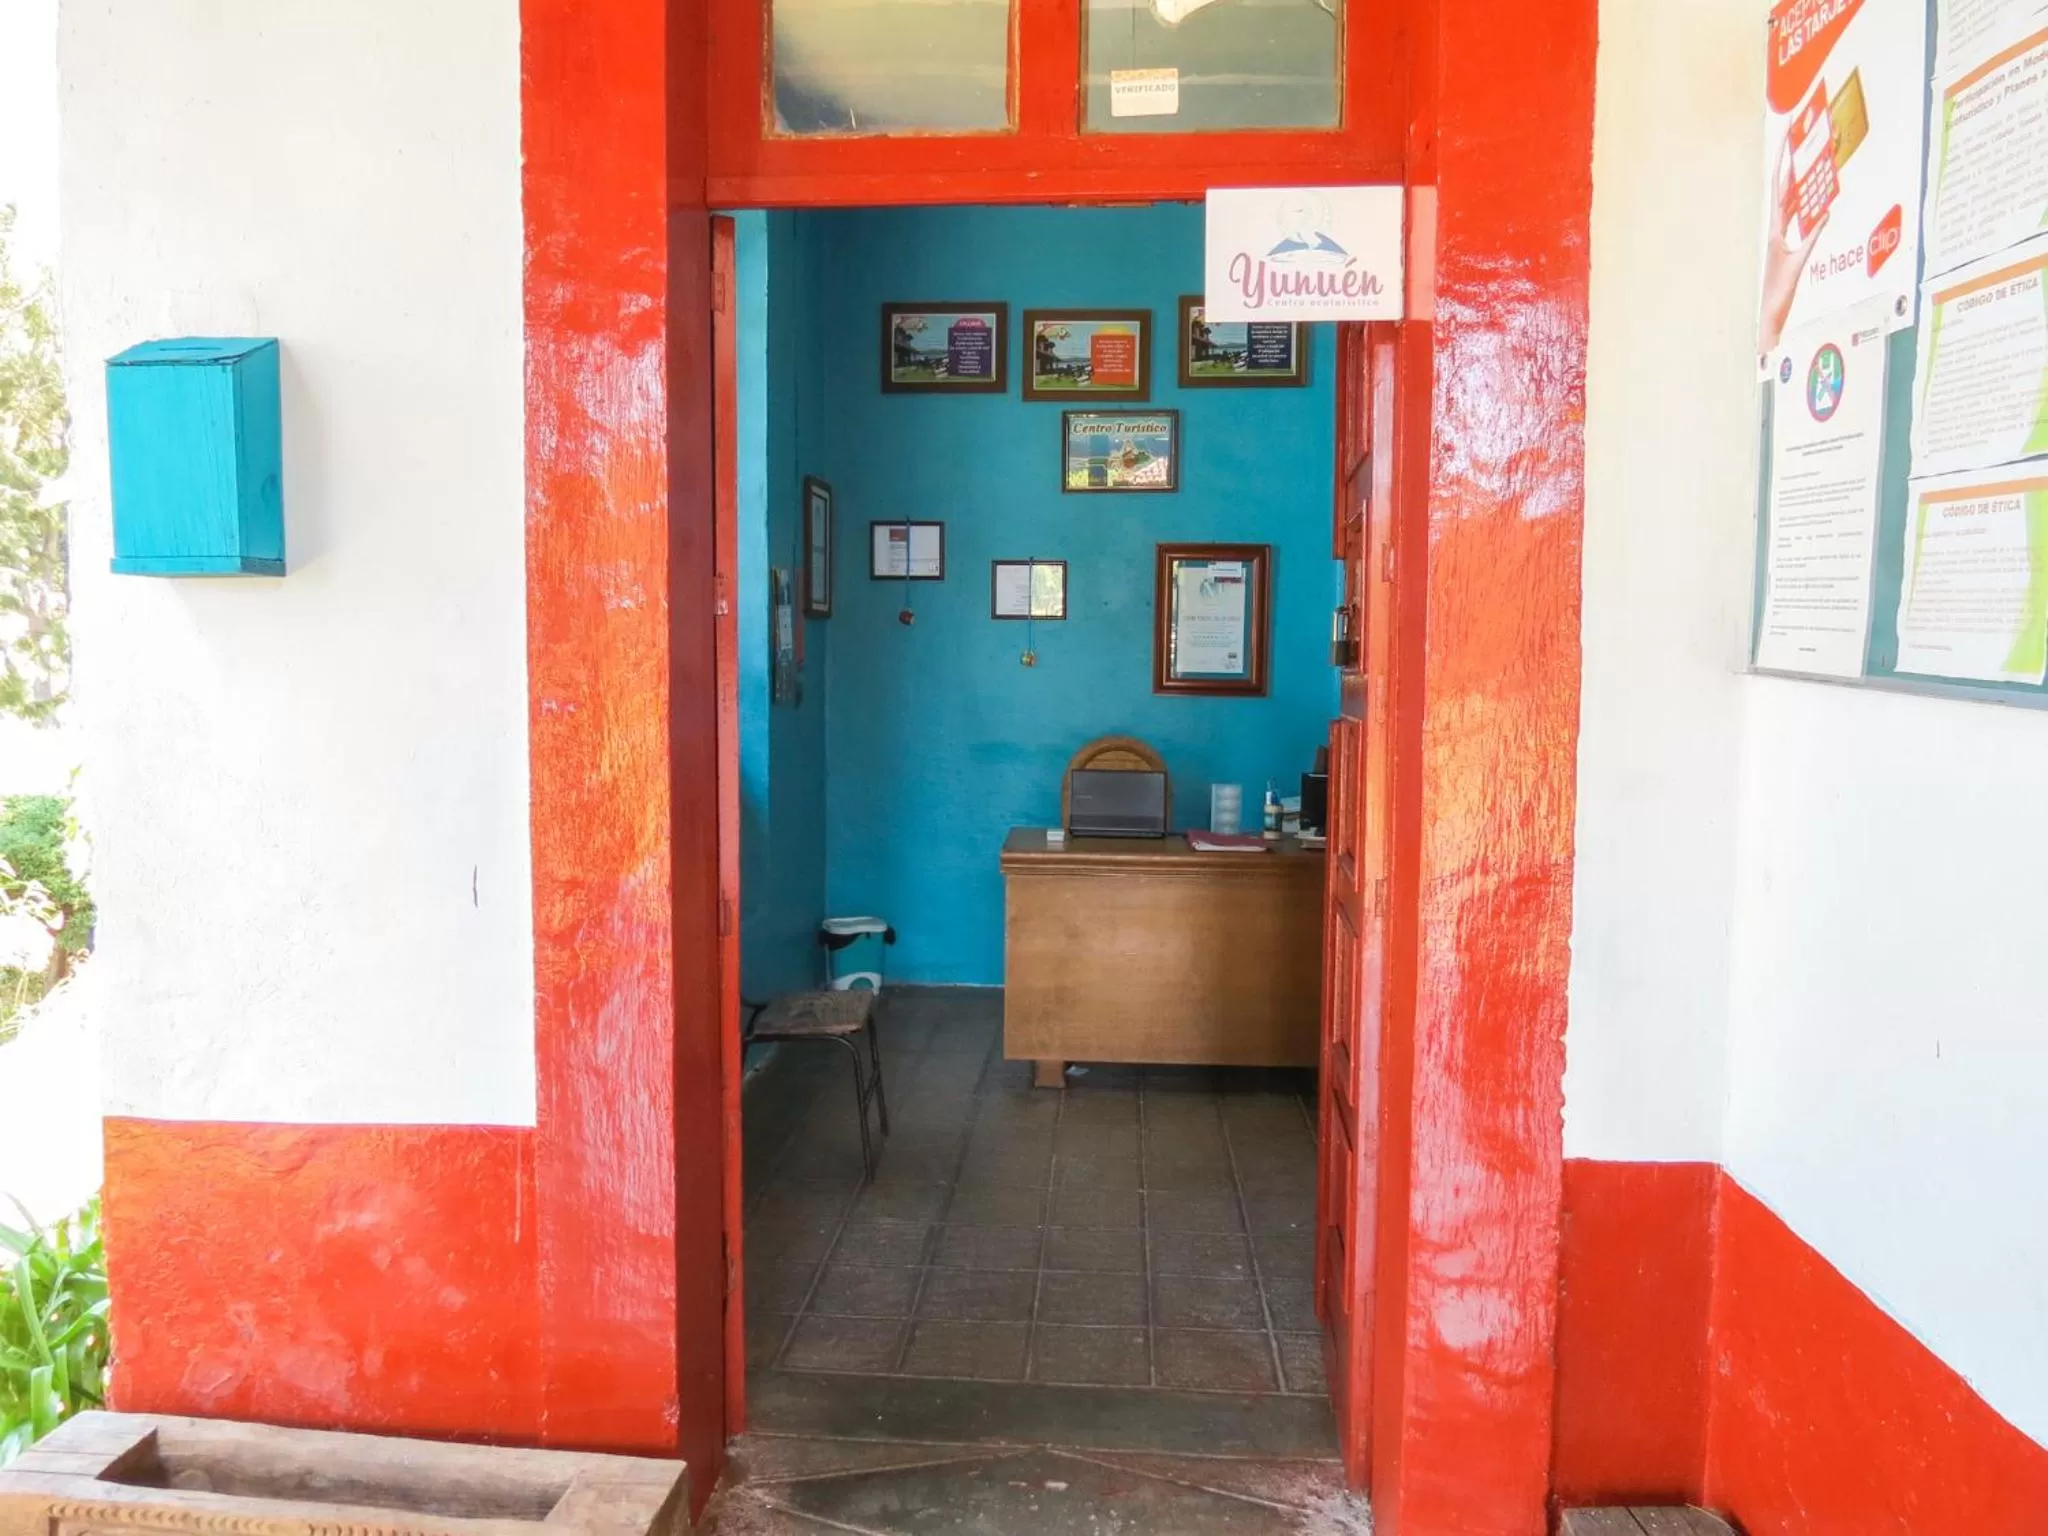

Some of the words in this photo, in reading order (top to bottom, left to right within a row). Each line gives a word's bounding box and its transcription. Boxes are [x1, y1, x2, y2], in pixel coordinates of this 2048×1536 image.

[1779, 27, 1802, 66] LAS
[1115, 83, 1176, 94] VERIFICADO
[1810, 261, 1826, 287] Me
[1830, 245, 1865, 275] hace
[1868, 226, 1900, 257] clip
[1229, 252, 1384, 309] Yunuén
[1995, 286, 2008, 301] DE
[1267, 298, 1305, 307] Centro
[1073, 421, 1113, 434] Centro
[1977, 502, 1990, 515] DE
